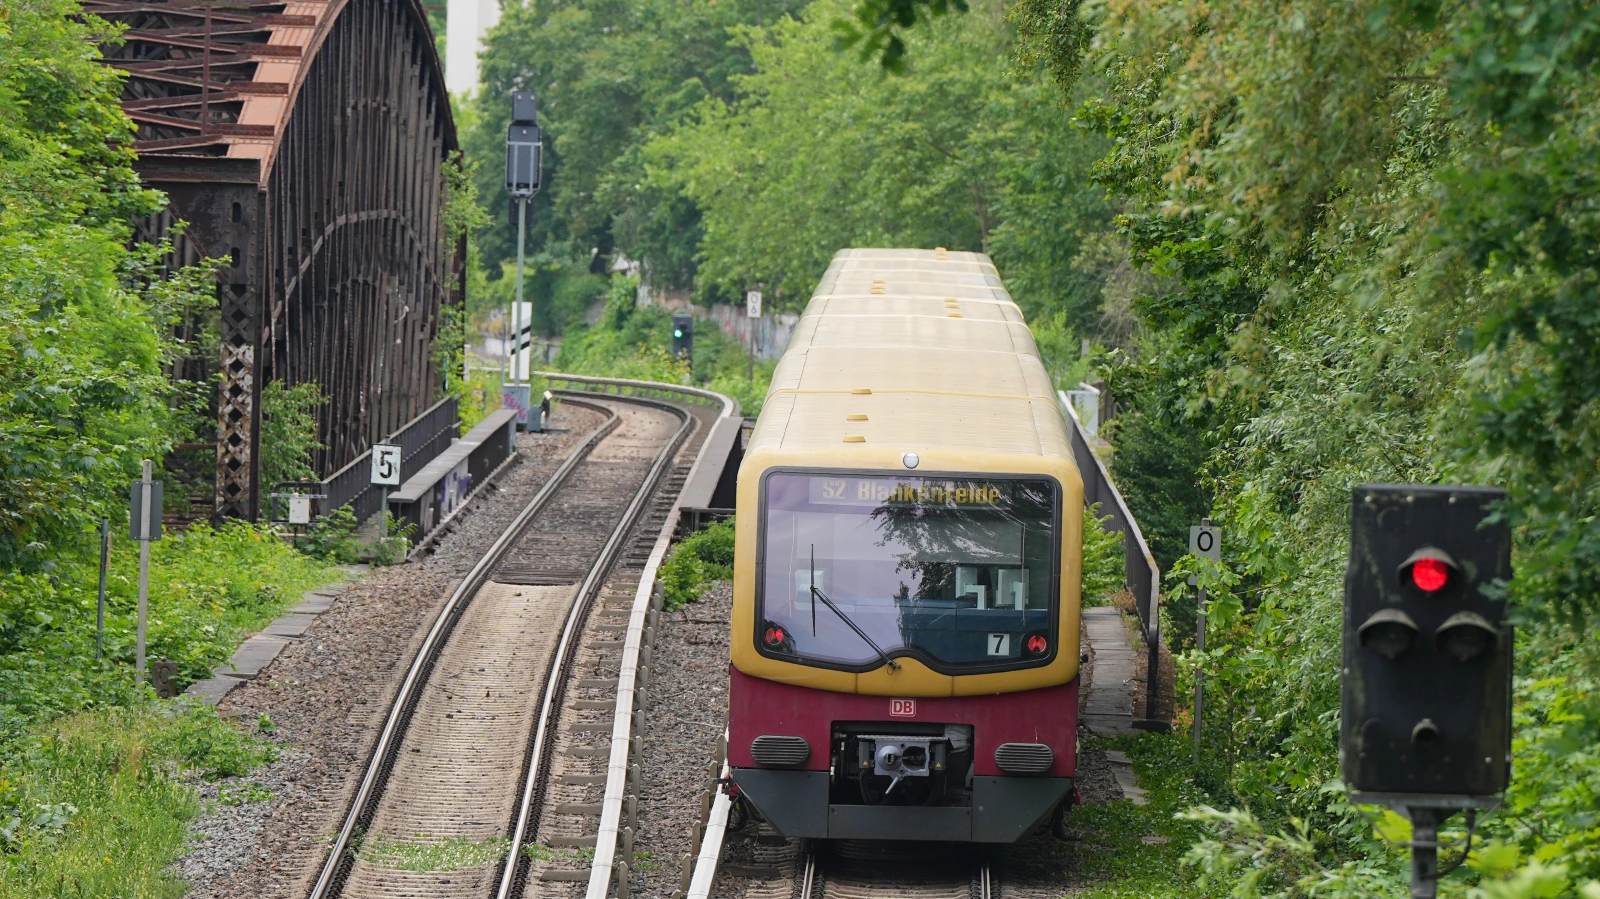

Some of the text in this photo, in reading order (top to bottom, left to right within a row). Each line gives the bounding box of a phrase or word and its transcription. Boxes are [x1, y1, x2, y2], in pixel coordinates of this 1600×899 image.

[379, 450, 393, 479] 5
[822, 479, 1002, 505] S2 Blankenfelde
[1196, 530, 1214, 552] 0
[992, 634, 1005, 654] 7
[893, 700, 913, 714] DB
